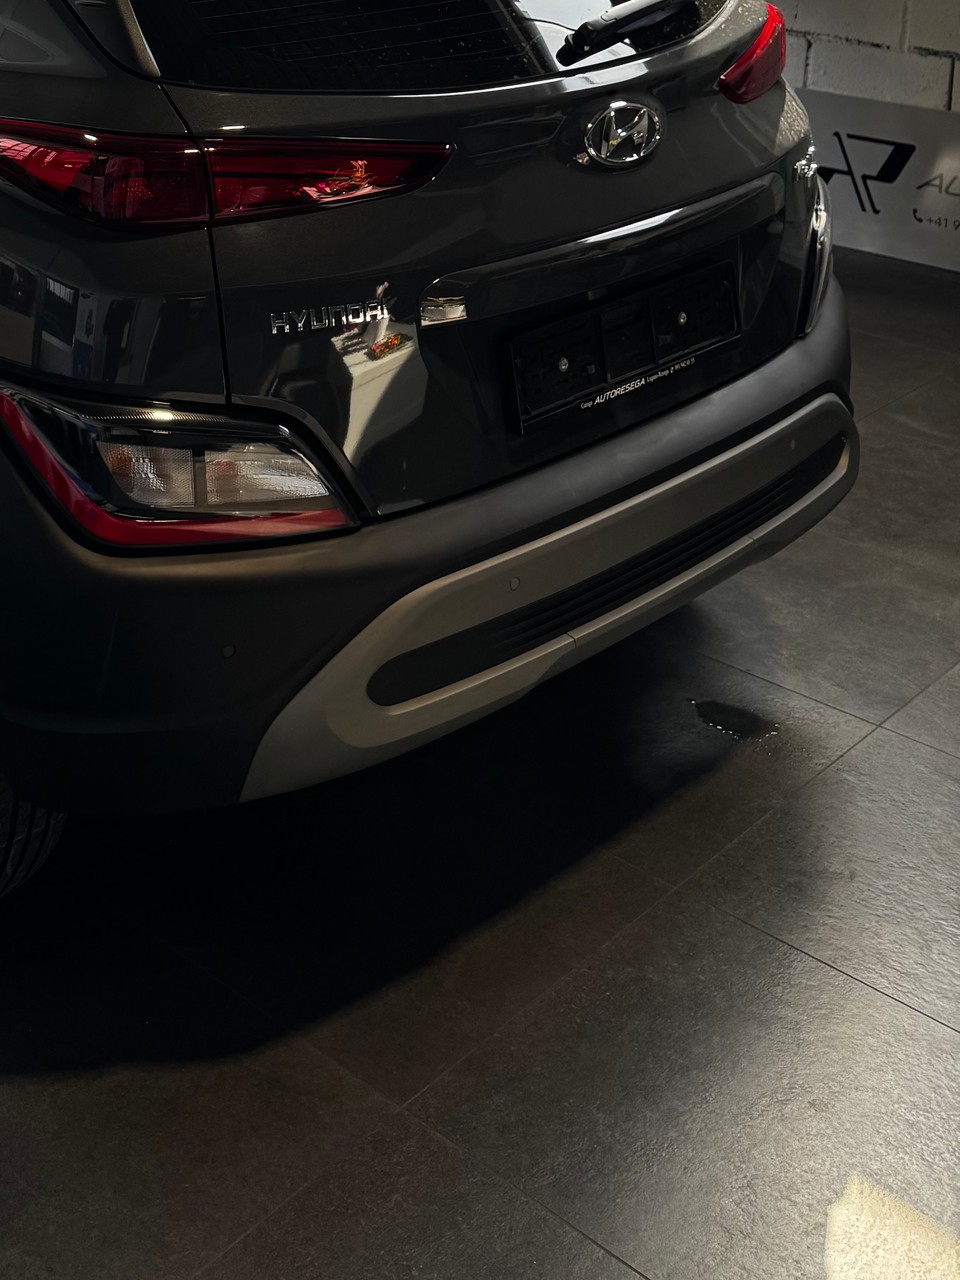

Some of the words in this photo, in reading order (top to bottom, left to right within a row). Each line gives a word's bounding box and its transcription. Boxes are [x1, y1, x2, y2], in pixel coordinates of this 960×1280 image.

[928, 217, 948, 229] +41
[270, 298, 389, 334] HYUNDAI
[594, 377, 646, 406] AUTORESEGA
